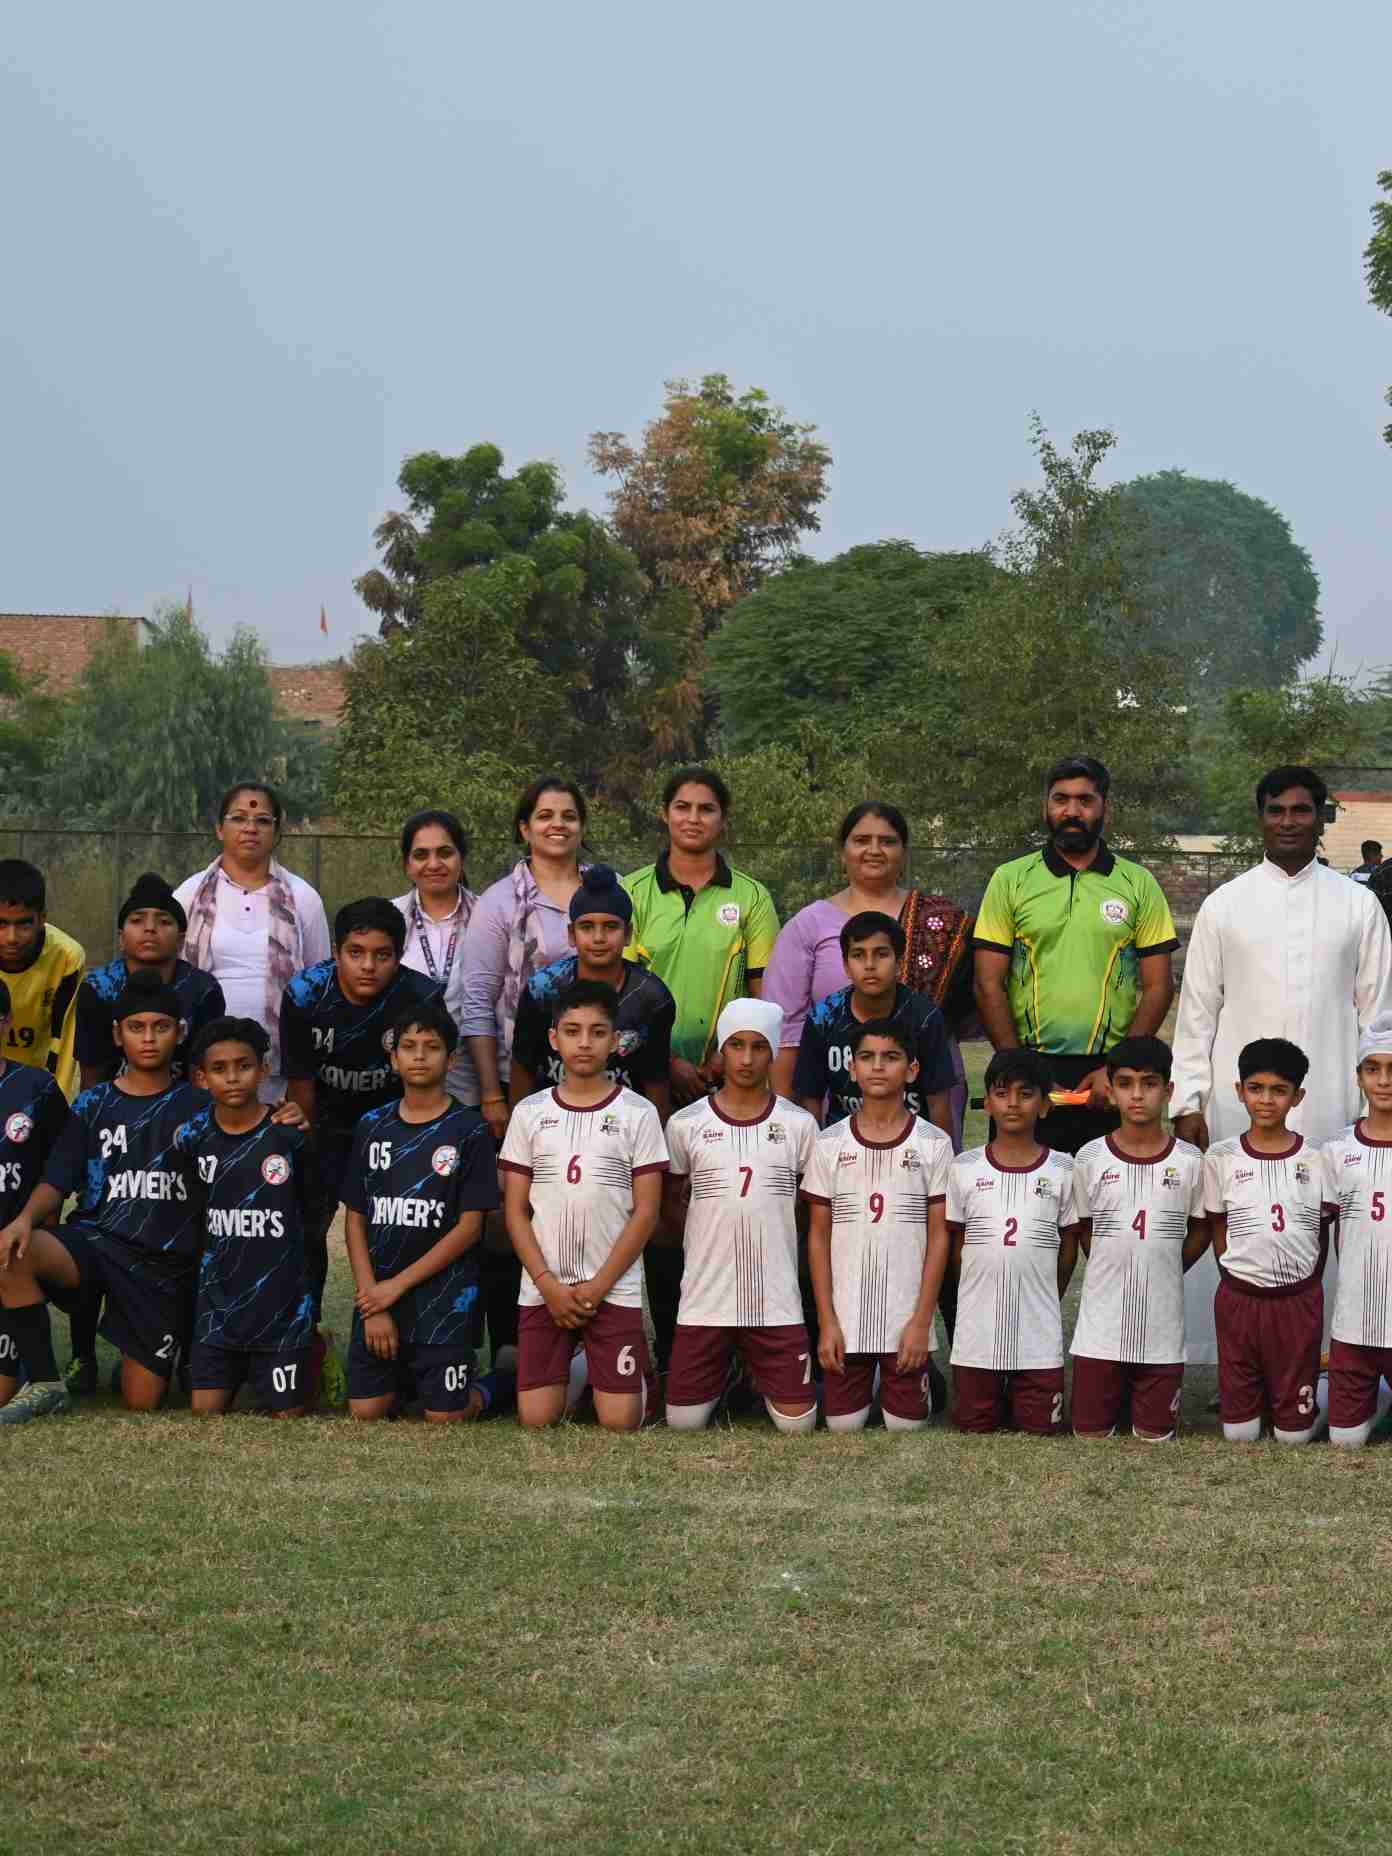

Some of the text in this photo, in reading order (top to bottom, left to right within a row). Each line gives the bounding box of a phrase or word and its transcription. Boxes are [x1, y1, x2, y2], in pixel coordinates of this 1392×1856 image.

[7, 1027, 34, 1048] 19
[100, 1124, 127, 1158] 24
[369, 1142, 392, 1170] 05
[566, 1154, 582, 1185] 6
[738, 1166, 753, 1198] 7
[106, 1169, 188, 1202] XAVIER'S
[869, 1192, 885, 1223] 9
[1270, 1204, 1285, 1233] 3
[1370, 1192, 1385, 1221] 5
[1003, 1217, 1018, 1247] 2
[1131, 1209, 1147, 1240] 4
[617, 1345, 636, 1376] 6
[798, 1353, 811, 1384] 7
[272, 1364, 298, 1392] 07
[444, 1364, 467, 1392] 05
[1050, 1391, 1063, 1423] 2
[1298, 1384, 1314, 1414] 3
